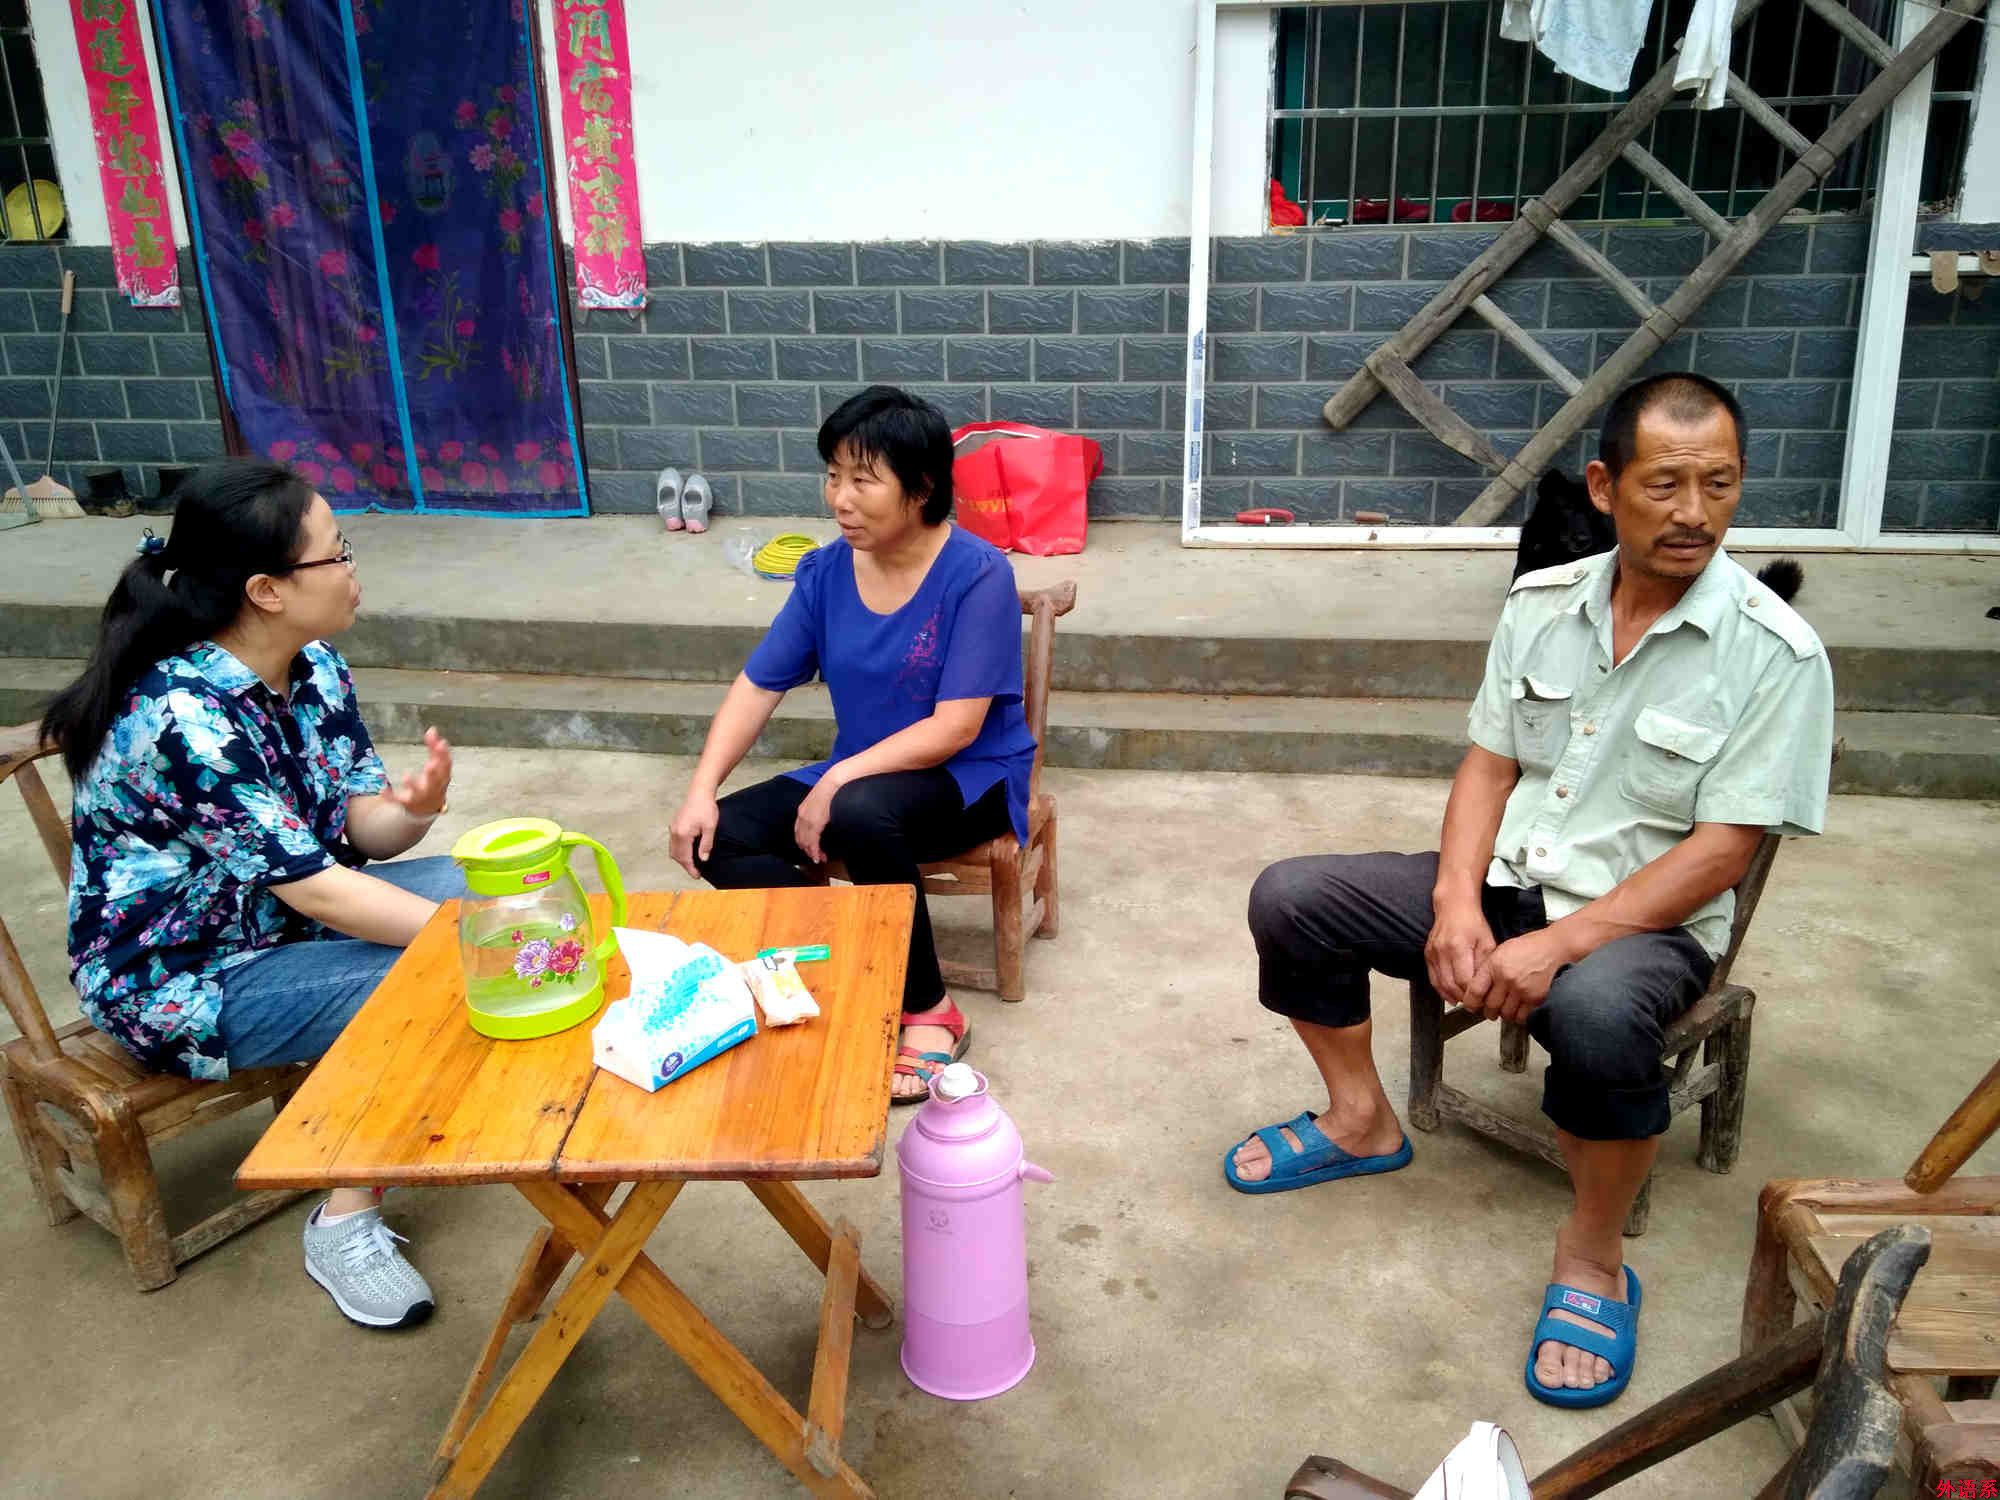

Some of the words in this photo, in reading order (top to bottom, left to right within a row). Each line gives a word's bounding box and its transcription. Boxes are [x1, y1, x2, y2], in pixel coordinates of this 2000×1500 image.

[562, 0, 630, 260] 門富貴吉祥
